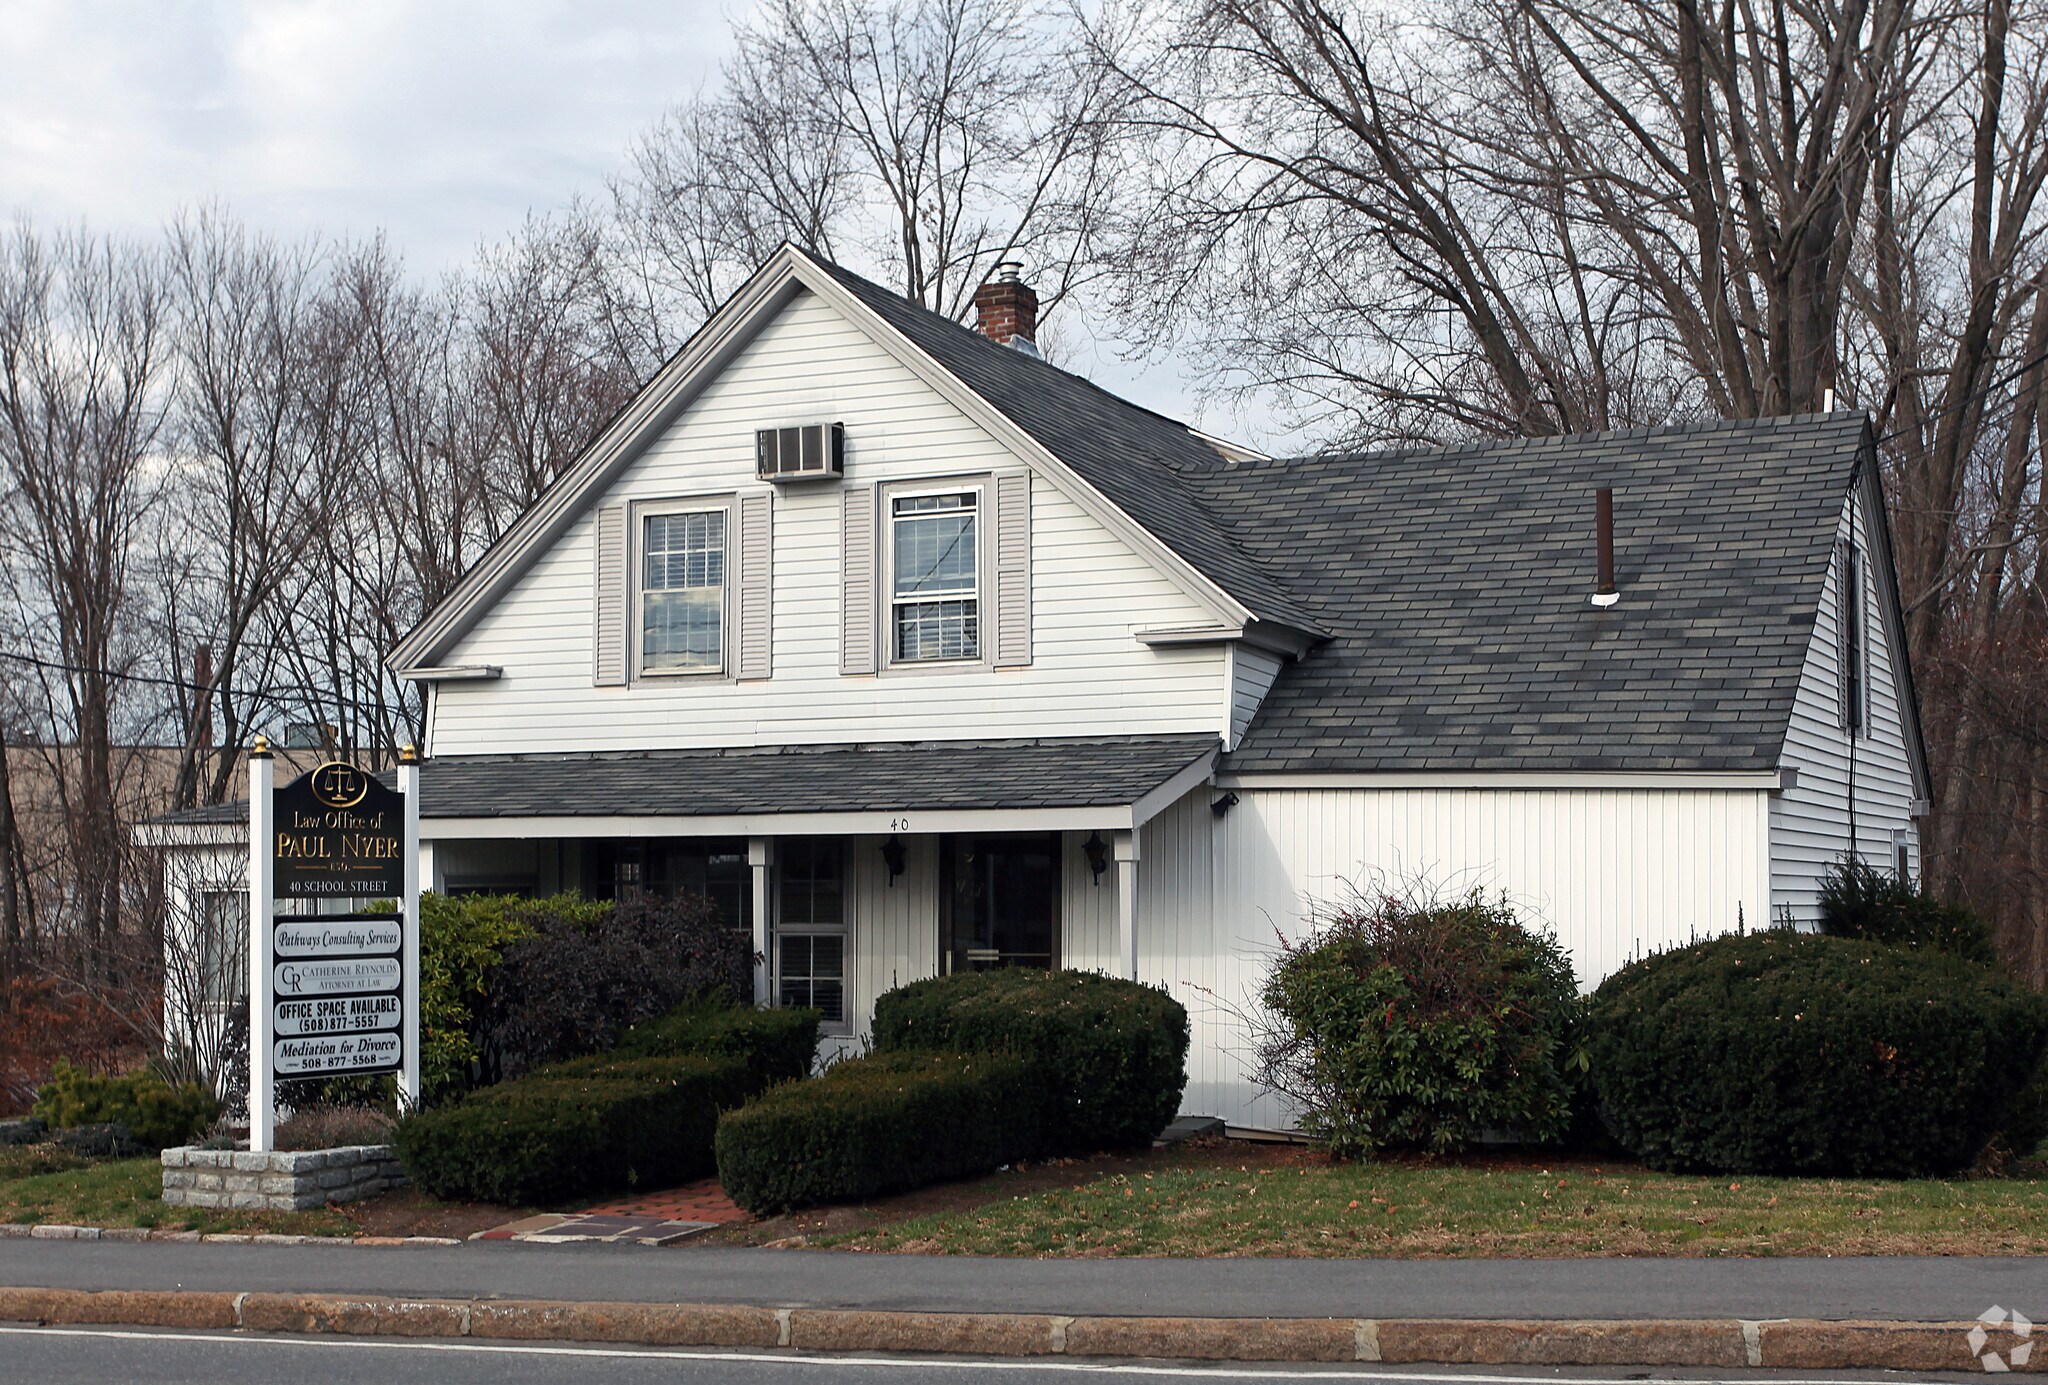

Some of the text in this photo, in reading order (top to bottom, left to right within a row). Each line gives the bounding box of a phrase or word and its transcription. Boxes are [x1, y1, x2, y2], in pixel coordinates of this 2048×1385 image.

[294, 811, 385, 829] Law Office of
[890, 818, 909, 831] 40
[277, 832, 399, 858] PAUL NYER
[289, 880, 388, 892] 40 SCHOOL STREET
[279, 929, 398, 950] Pathways Consulting Services
[302, 964, 397, 977] CATHERINE REYNOLDS
[319, 978, 382, 990] ATTORNEY AT LAW
[280, 998, 397, 1019] OFFICE SPACE AVAILABLE
[299, 1015, 379, 1032] (508)877-5557
[280, 1038, 397, 1058] Mediation for Divorce
[301, 1054, 377, 1069] 508-877-5568
